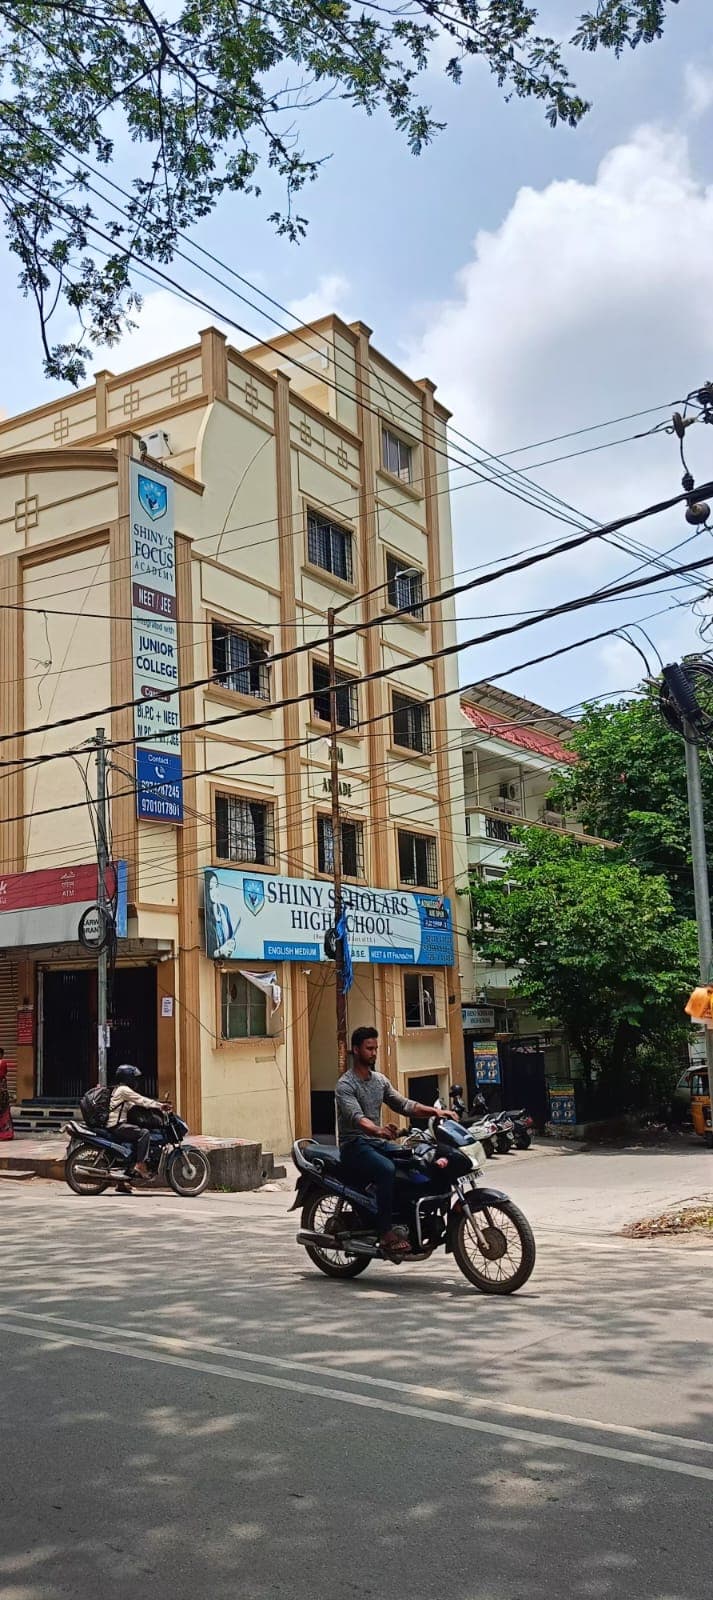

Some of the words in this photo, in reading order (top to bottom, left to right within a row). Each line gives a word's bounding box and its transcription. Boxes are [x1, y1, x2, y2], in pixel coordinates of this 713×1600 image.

[133, 523, 174, 550] SHINY'S
[134, 540, 174, 569] FOCUS
[134, 561, 174, 582] ACADEMY
[138, 588, 155, 608] NEET
[160, 595, 172, 613] JEE
[139, 636, 174, 658] JUNIOR
[136, 655, 177, 679] COLLEGE
[156, 711, 161, 722] +
[163, 710, 178, 726] NEET
[141, 798, 180, 816] 9701017801
[267, 881, 324, 908] SHINY
[291, 910, 332, 932] HIGH
[268, 946, 294, 955] ENGLISH
[294, 947, 316, 956] MEDIUM
[371, 950, 382, 959] NEET
